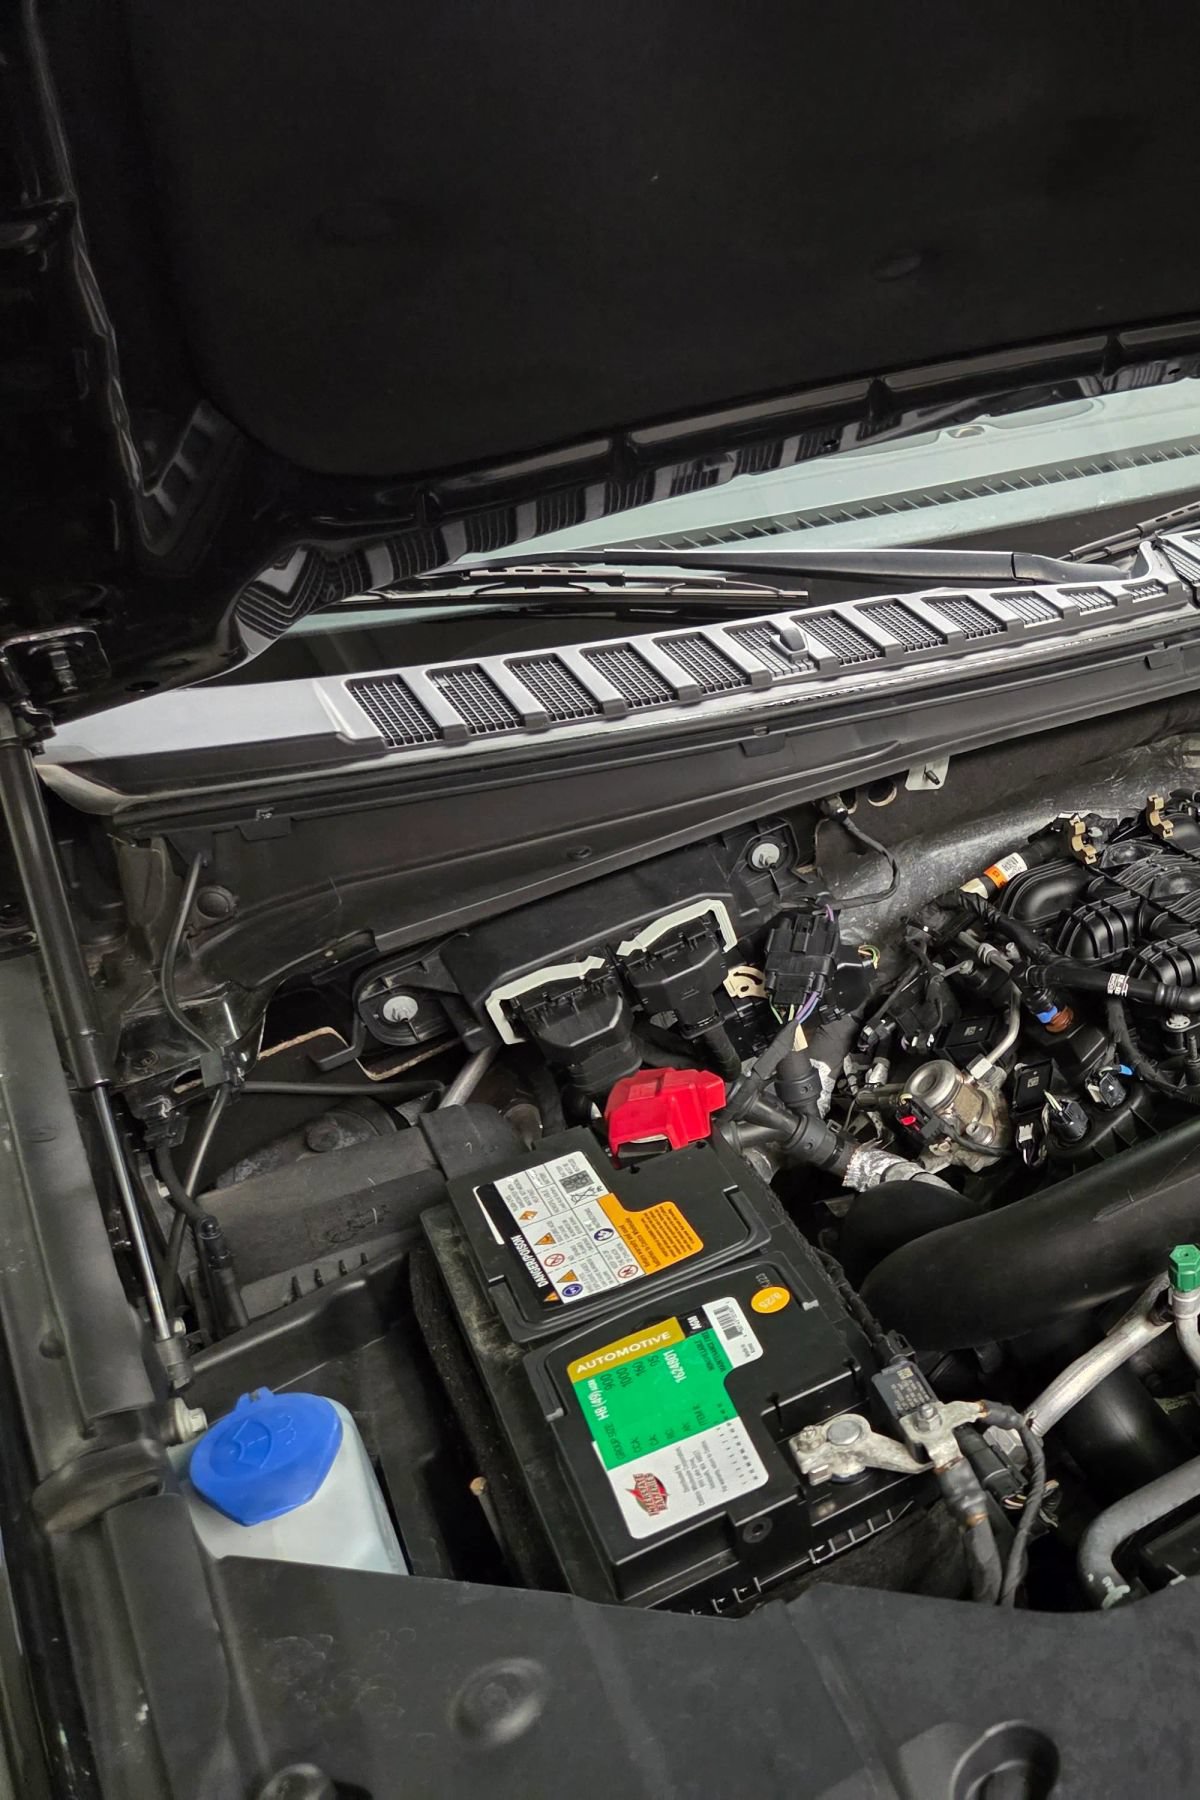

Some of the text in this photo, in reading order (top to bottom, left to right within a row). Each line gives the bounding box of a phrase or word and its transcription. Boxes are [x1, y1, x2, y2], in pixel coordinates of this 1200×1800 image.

[511, 1234, 549, 1288] DANGER/POISON
[687, 1315, 701, 1329] AGM
[576, 1331, 671, 1373] AUTOMOTIVE
[632, 1360, 646, 1376] 160
[663, 1349, 686, 1382] 1624801
[600, 1373, 615, 1390] 900
[615, 1367, 632, 1387] 1000
[588, 1390, 606, 1407] (49)
[594, 1406, 608, 1420] H8
